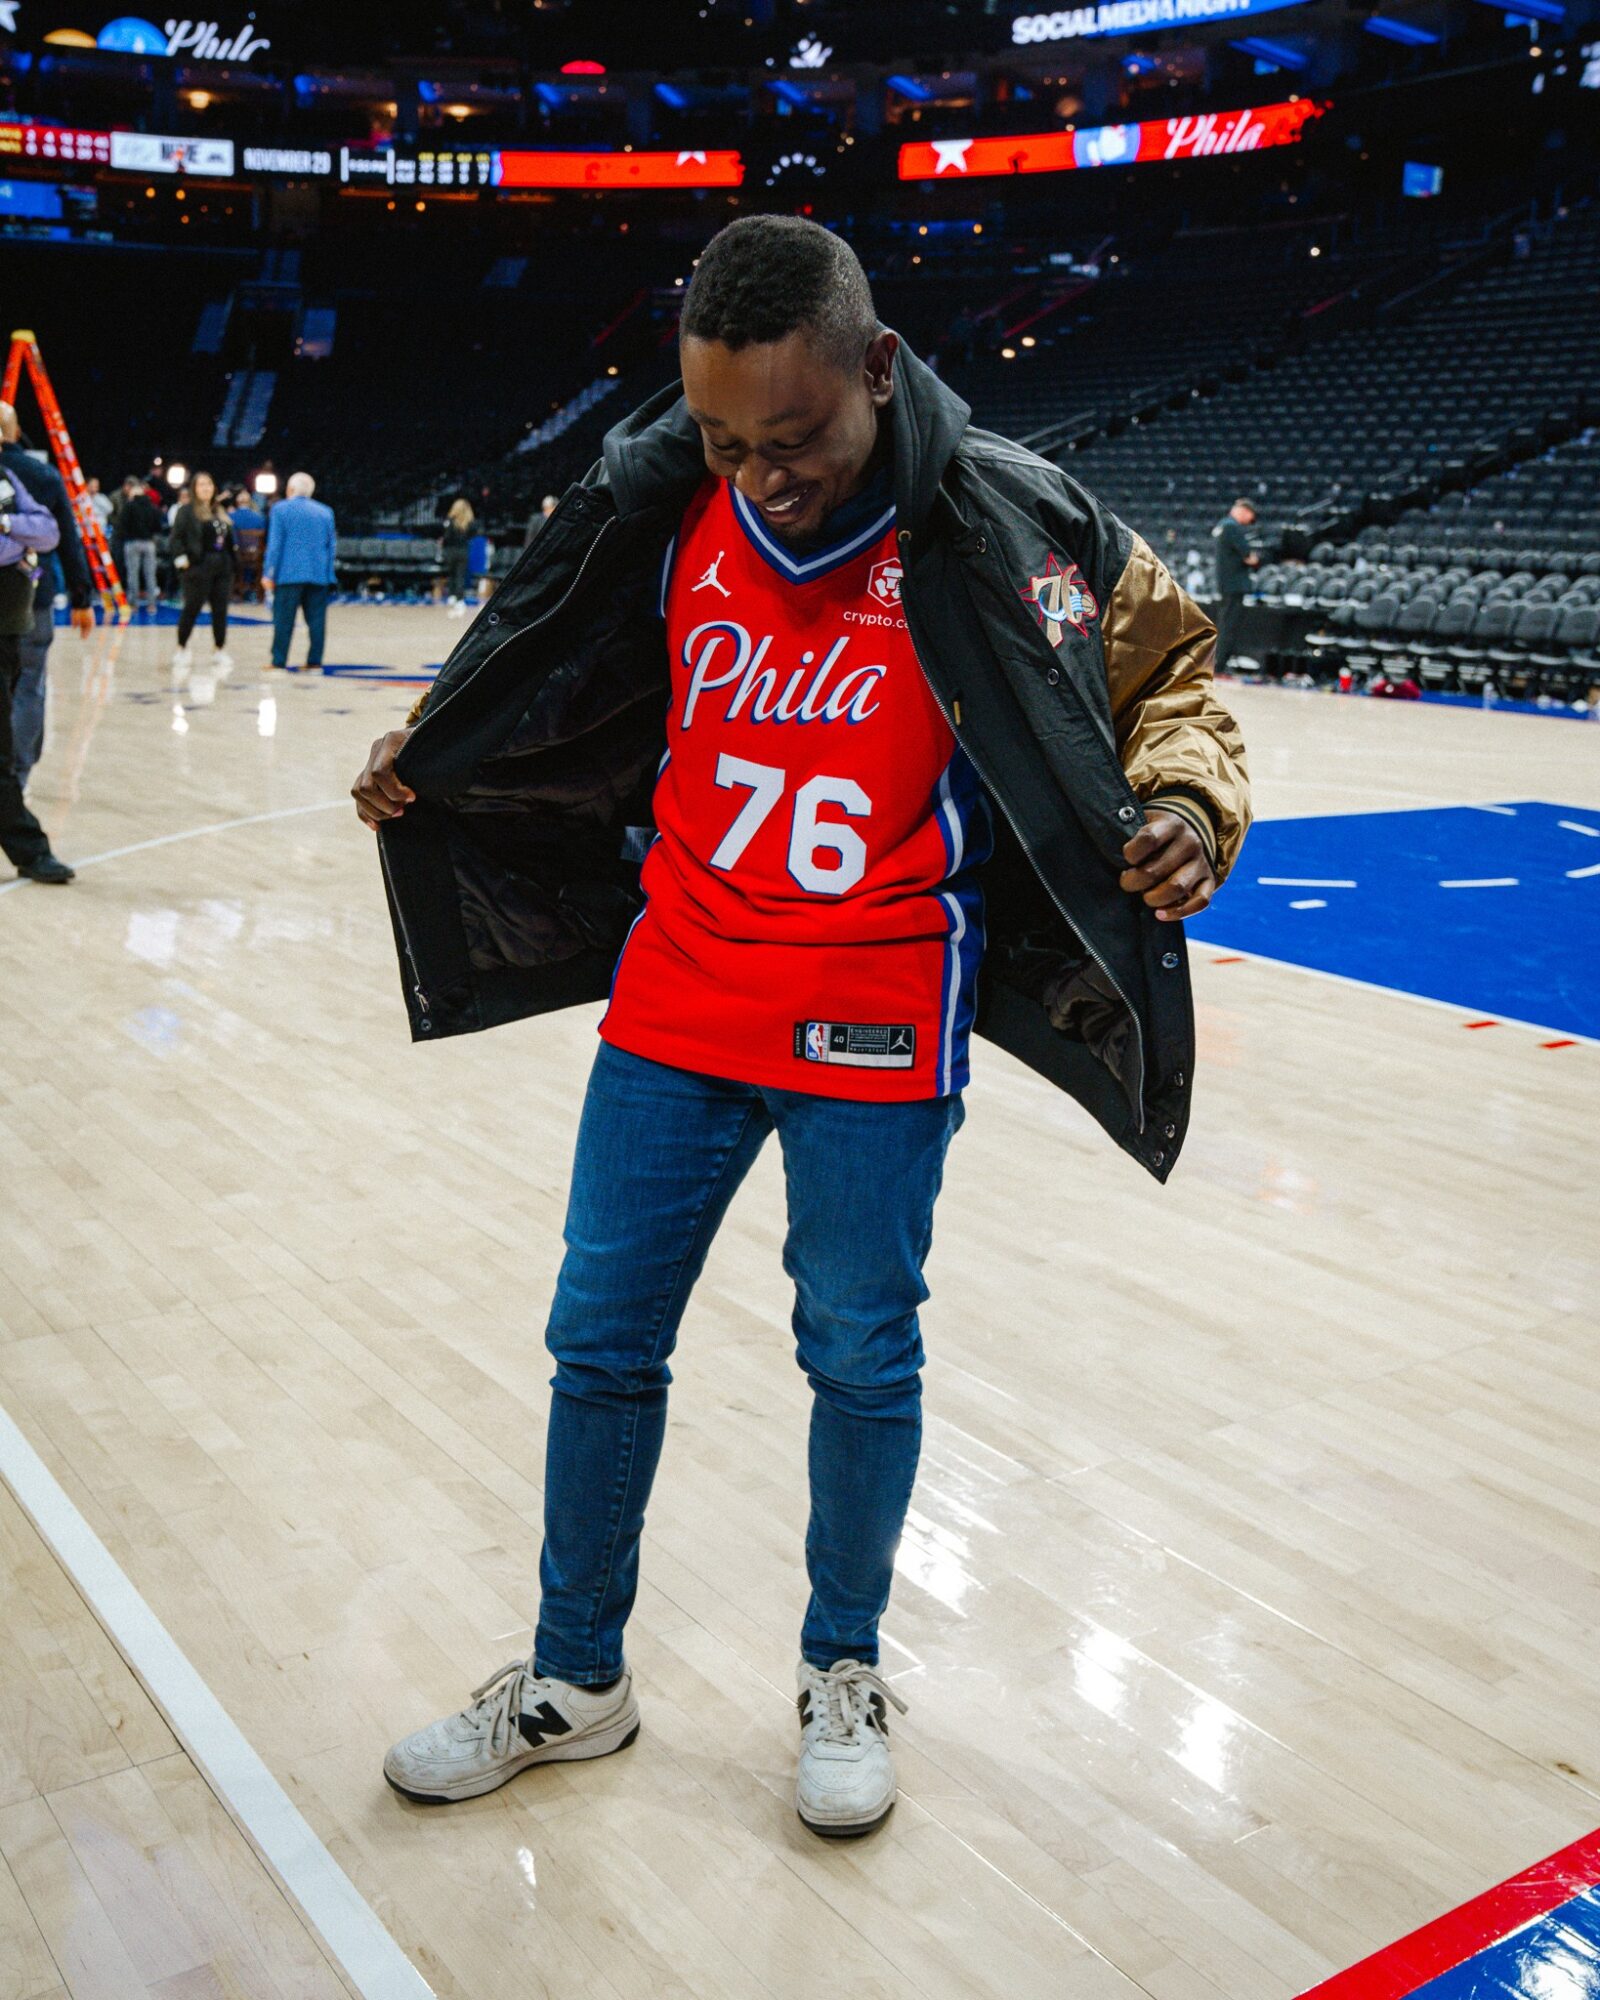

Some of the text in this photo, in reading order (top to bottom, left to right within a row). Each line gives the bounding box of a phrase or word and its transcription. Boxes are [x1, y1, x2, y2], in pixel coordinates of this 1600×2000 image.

[1012, 7, 1098, 44] SOCIAL
[1098, 0, 1174, 31] MEDIA
[1164, 109, 1266, 159] Phila
[681, 620, 887, 731] Phila
[708, 752, 872, 896] 76
[833, 1035, 845, 1044] 40
